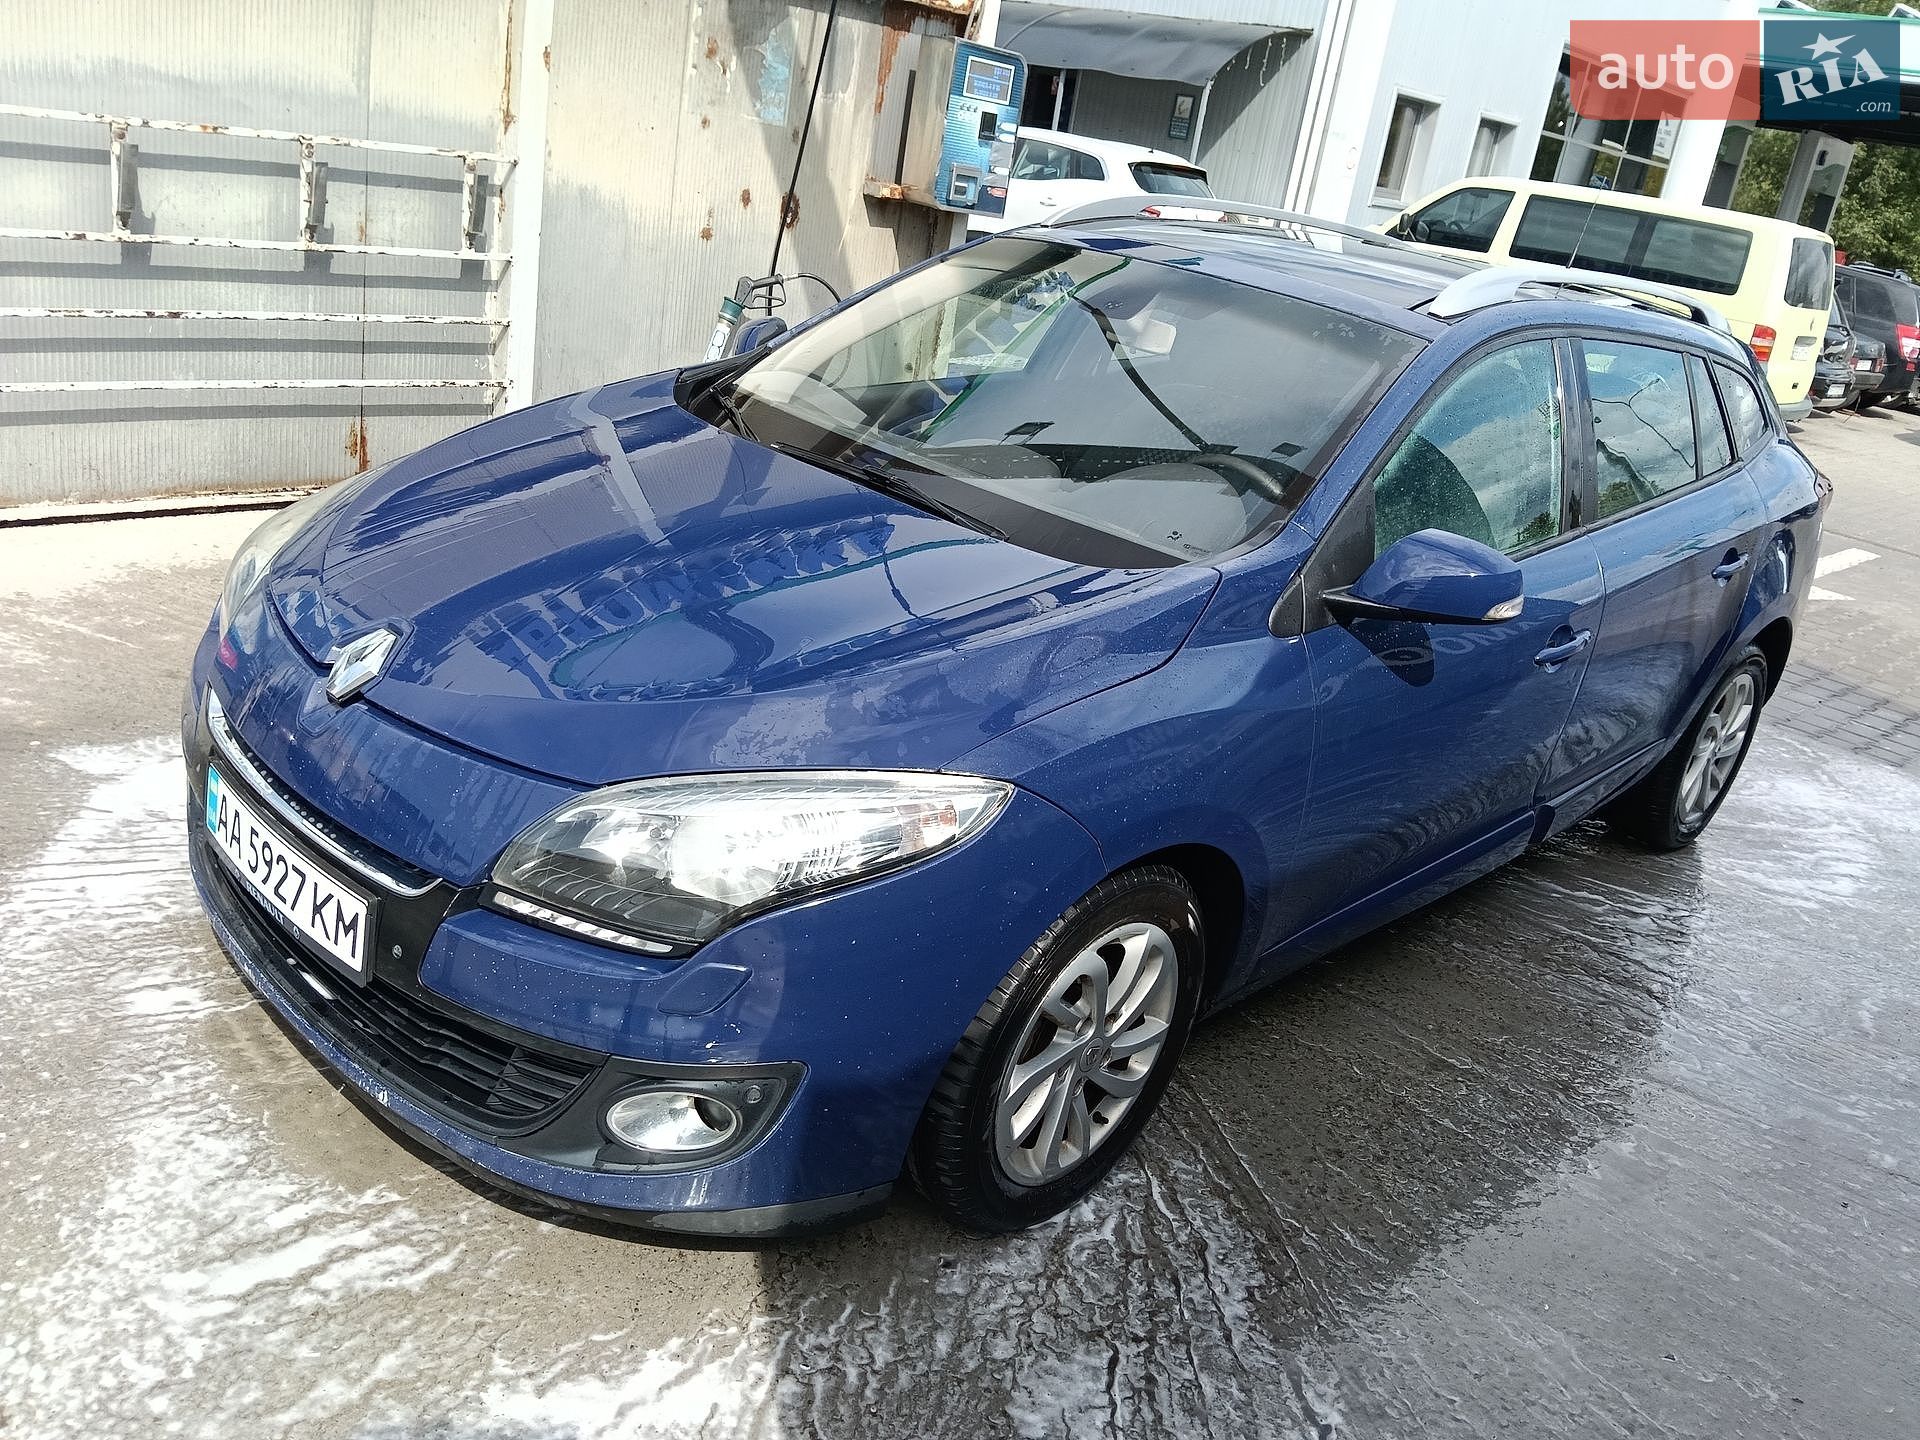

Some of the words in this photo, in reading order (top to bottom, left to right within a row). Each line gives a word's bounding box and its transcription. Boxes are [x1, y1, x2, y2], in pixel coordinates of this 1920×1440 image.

[217, 793, 242, 860] AA
[247, 825, 307, 912] 5927
[311, 881, 359, 959] KM
